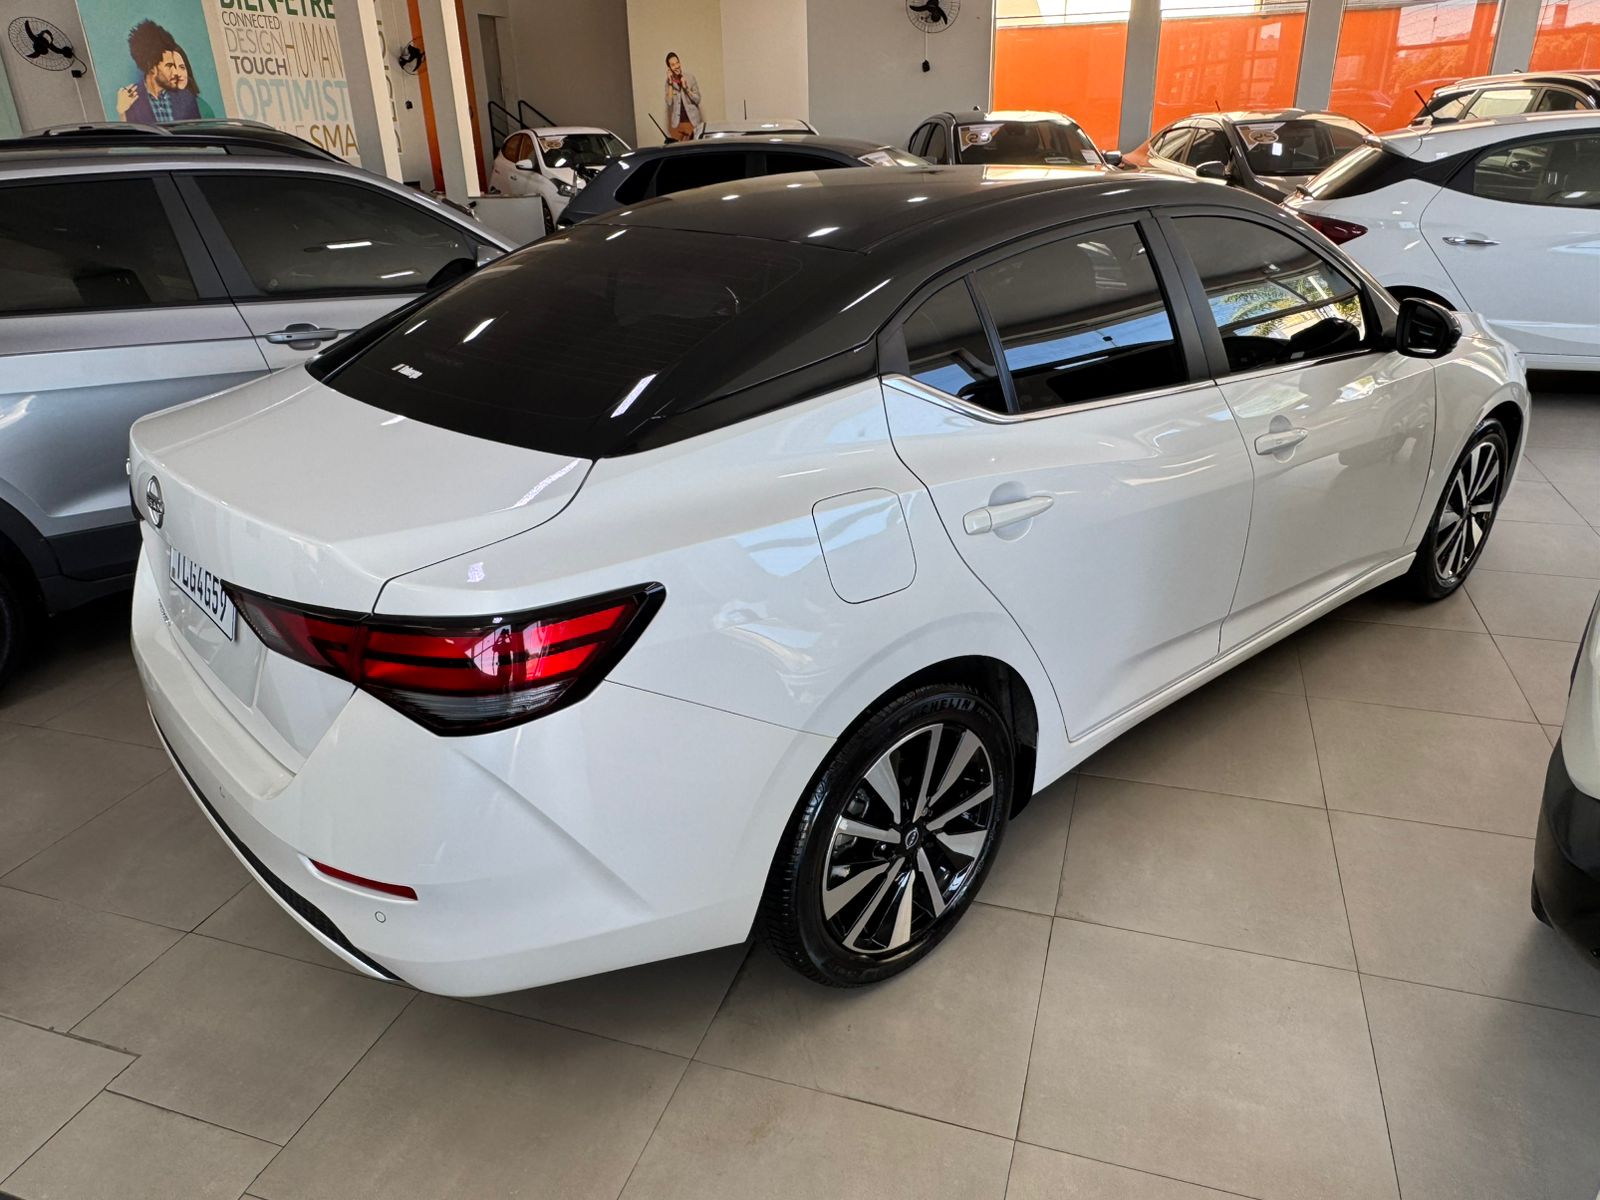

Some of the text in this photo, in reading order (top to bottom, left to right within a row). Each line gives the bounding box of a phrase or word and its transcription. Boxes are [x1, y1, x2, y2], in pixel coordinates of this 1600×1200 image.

[222, 11, 280, 30] CONNECTED
[224, 27, 285, 55] DESIGN
[281, 21, 344, 78] HUMAN
[230, 56, 288, 76] TOUCH
